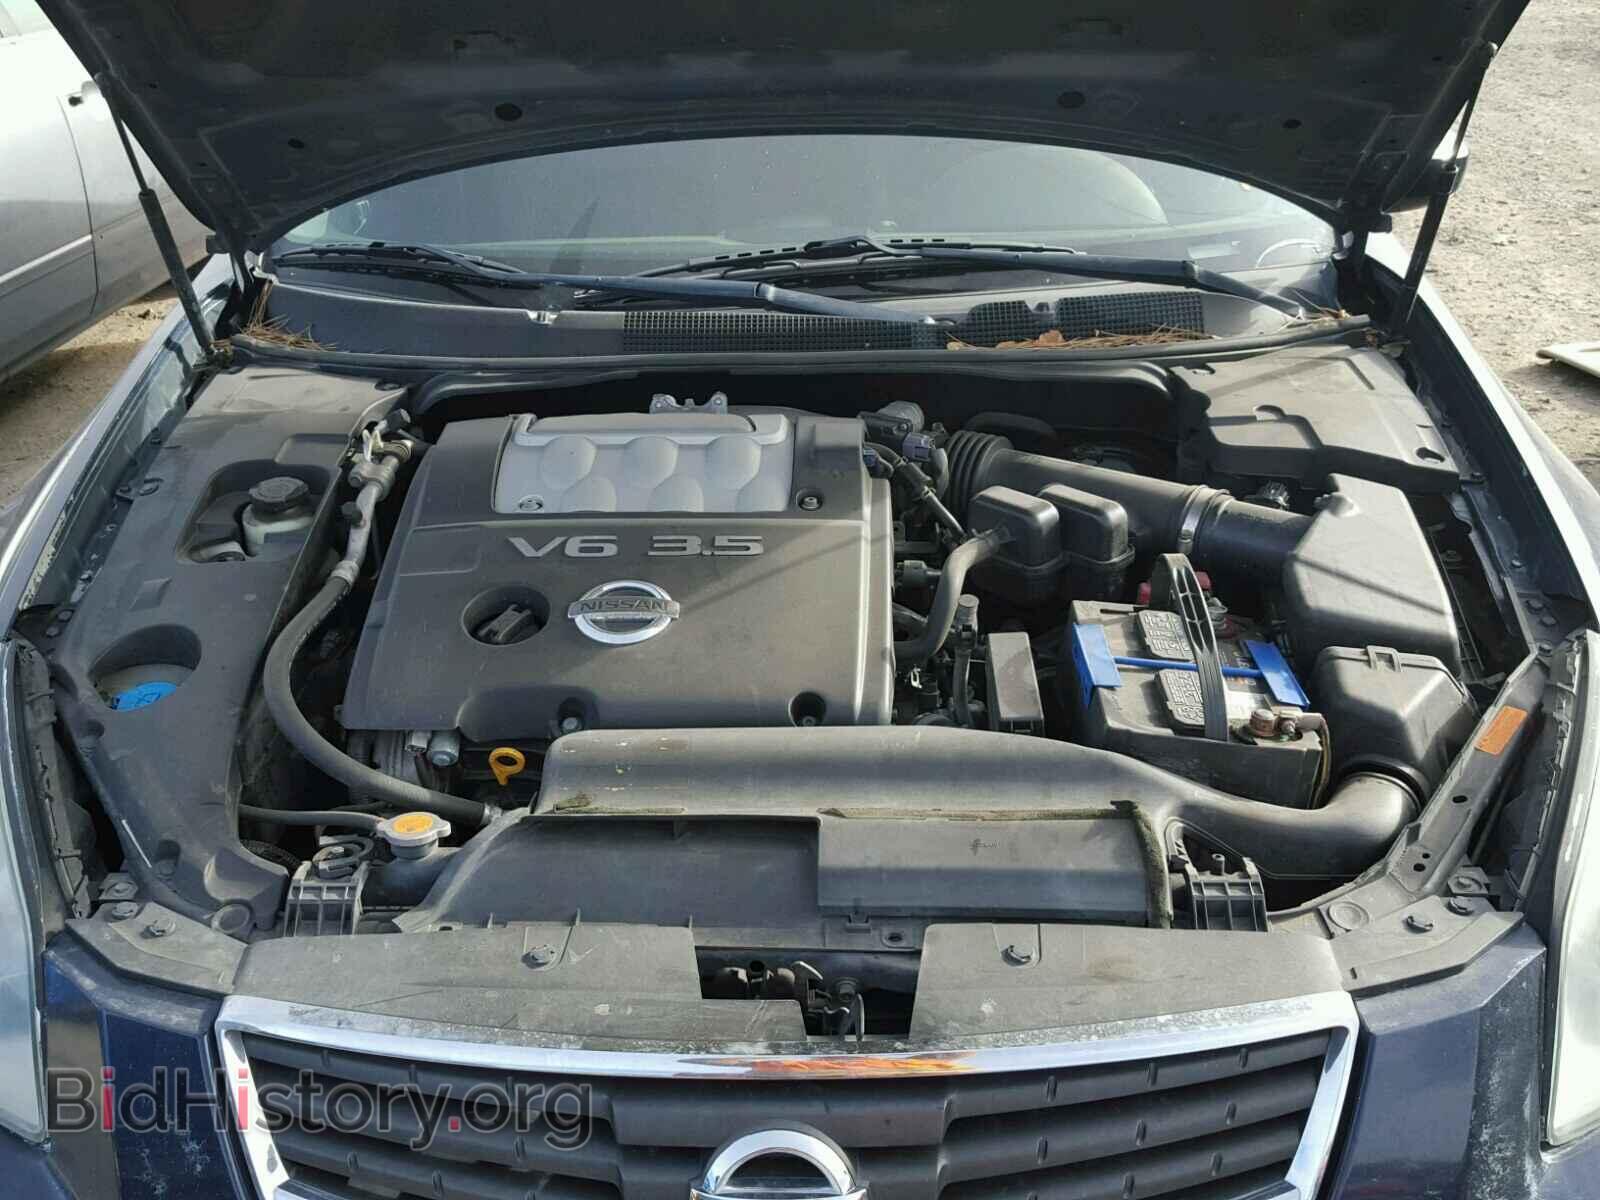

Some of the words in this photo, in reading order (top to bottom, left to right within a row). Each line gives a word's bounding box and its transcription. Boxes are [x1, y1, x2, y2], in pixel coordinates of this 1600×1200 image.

[507, 535, 619, 558] V6
[648, 535, 764, 557] 3.5
[579, 598, 669, 612] NISSAN
